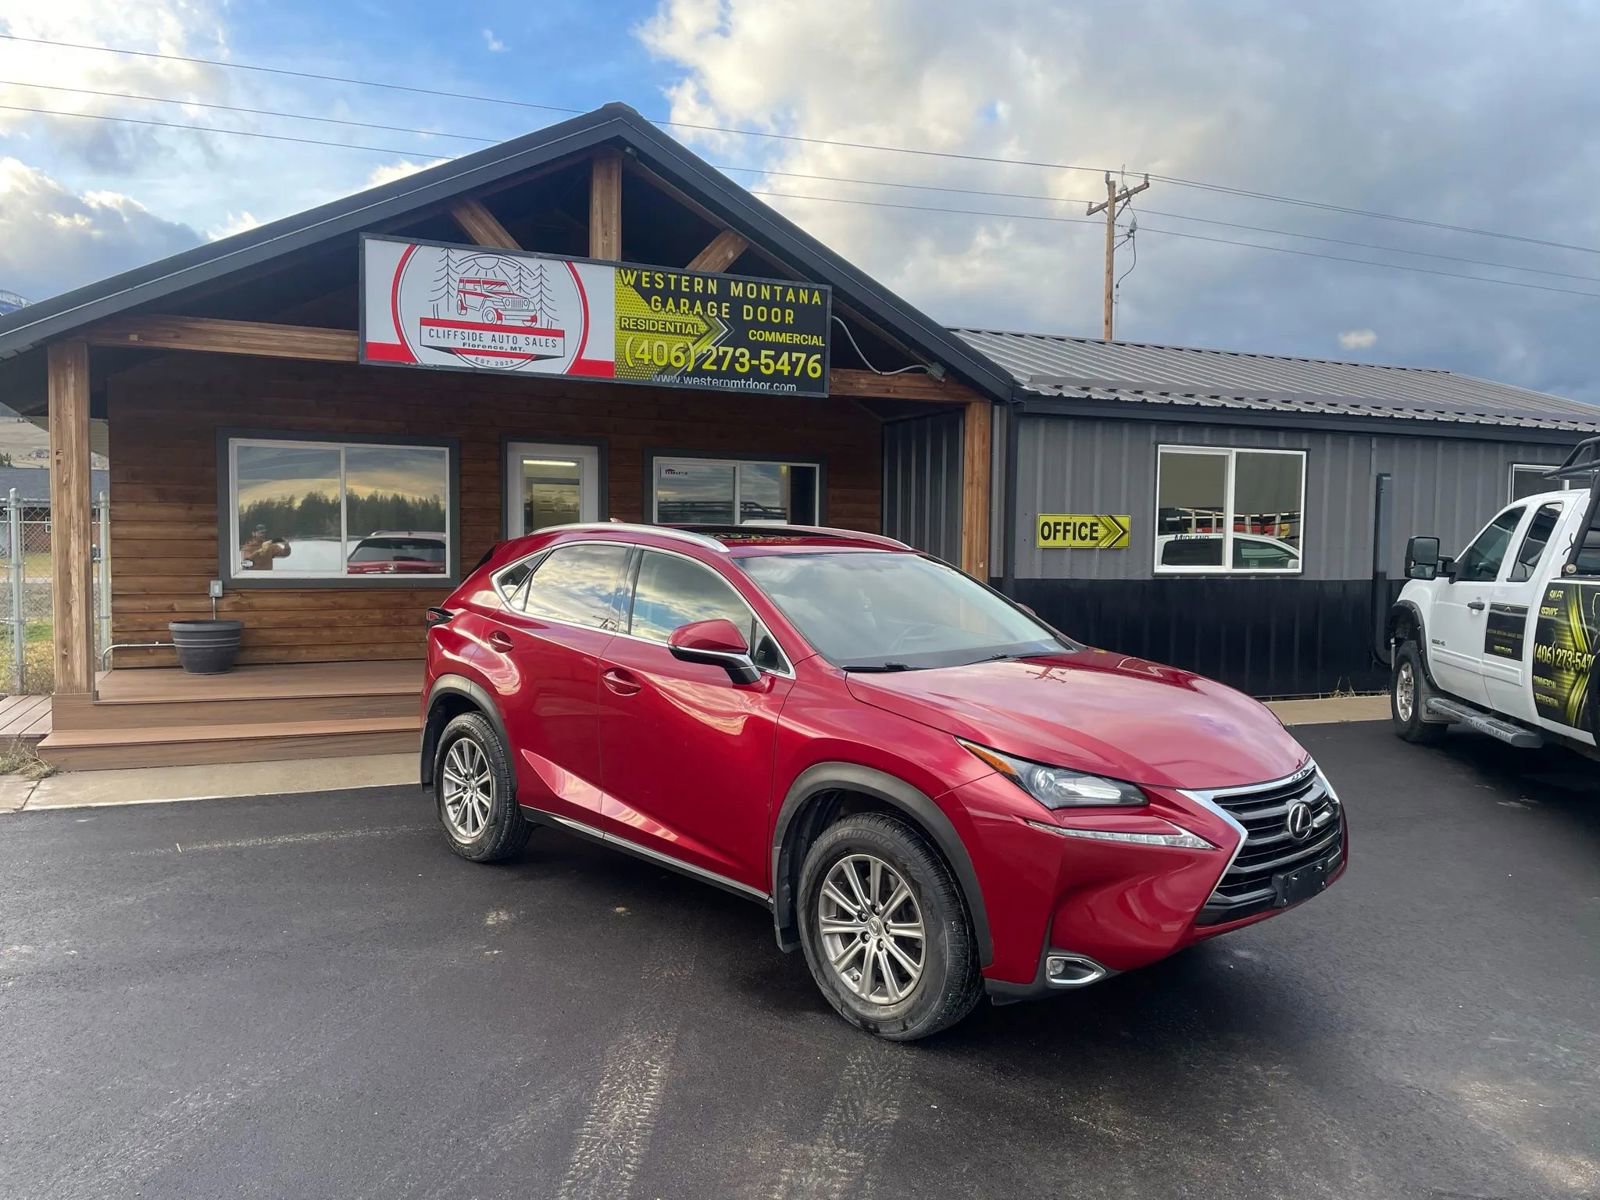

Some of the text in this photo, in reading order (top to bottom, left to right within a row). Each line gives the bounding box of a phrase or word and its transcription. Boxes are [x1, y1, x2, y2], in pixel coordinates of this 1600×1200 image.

[620, 269, 822, 305] WESTERN MONTANA
[651, 295, 795, 324] GARAGE DOOR
[620, 317, 701, 335] RESIDENTIAL
[429, 328, 557, 349] CLIFFSIDE AUTO SALES
[462, 341, 508, 351] Florence,
[748, 329, 826, 347] COMMERCIAL
[625, 337, 823, 379] (406) 273-5476
[651, 373, 797, 392] www.westernmtdoor.com
[1040, 521, 1099, 541] OFFICE
[1534, 642, 1555, 667] (406)
